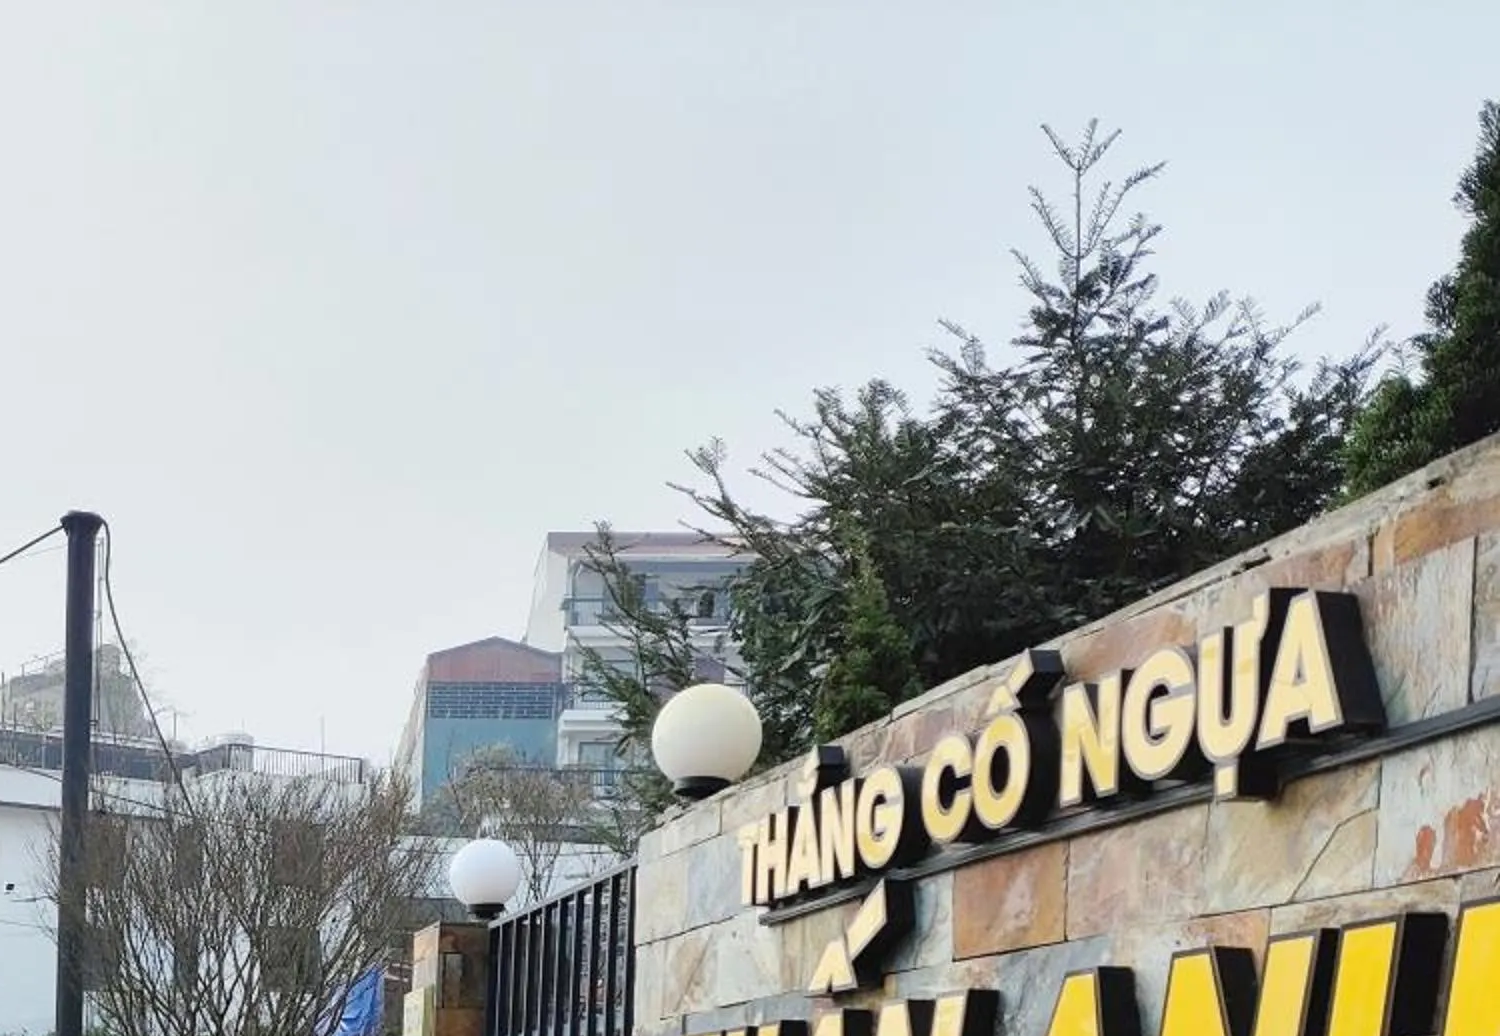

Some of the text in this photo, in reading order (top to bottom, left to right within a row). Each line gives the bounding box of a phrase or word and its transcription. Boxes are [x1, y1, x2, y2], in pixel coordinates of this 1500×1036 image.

[738, 590, 1344, 907] THẮNG CỐ NGỰA
